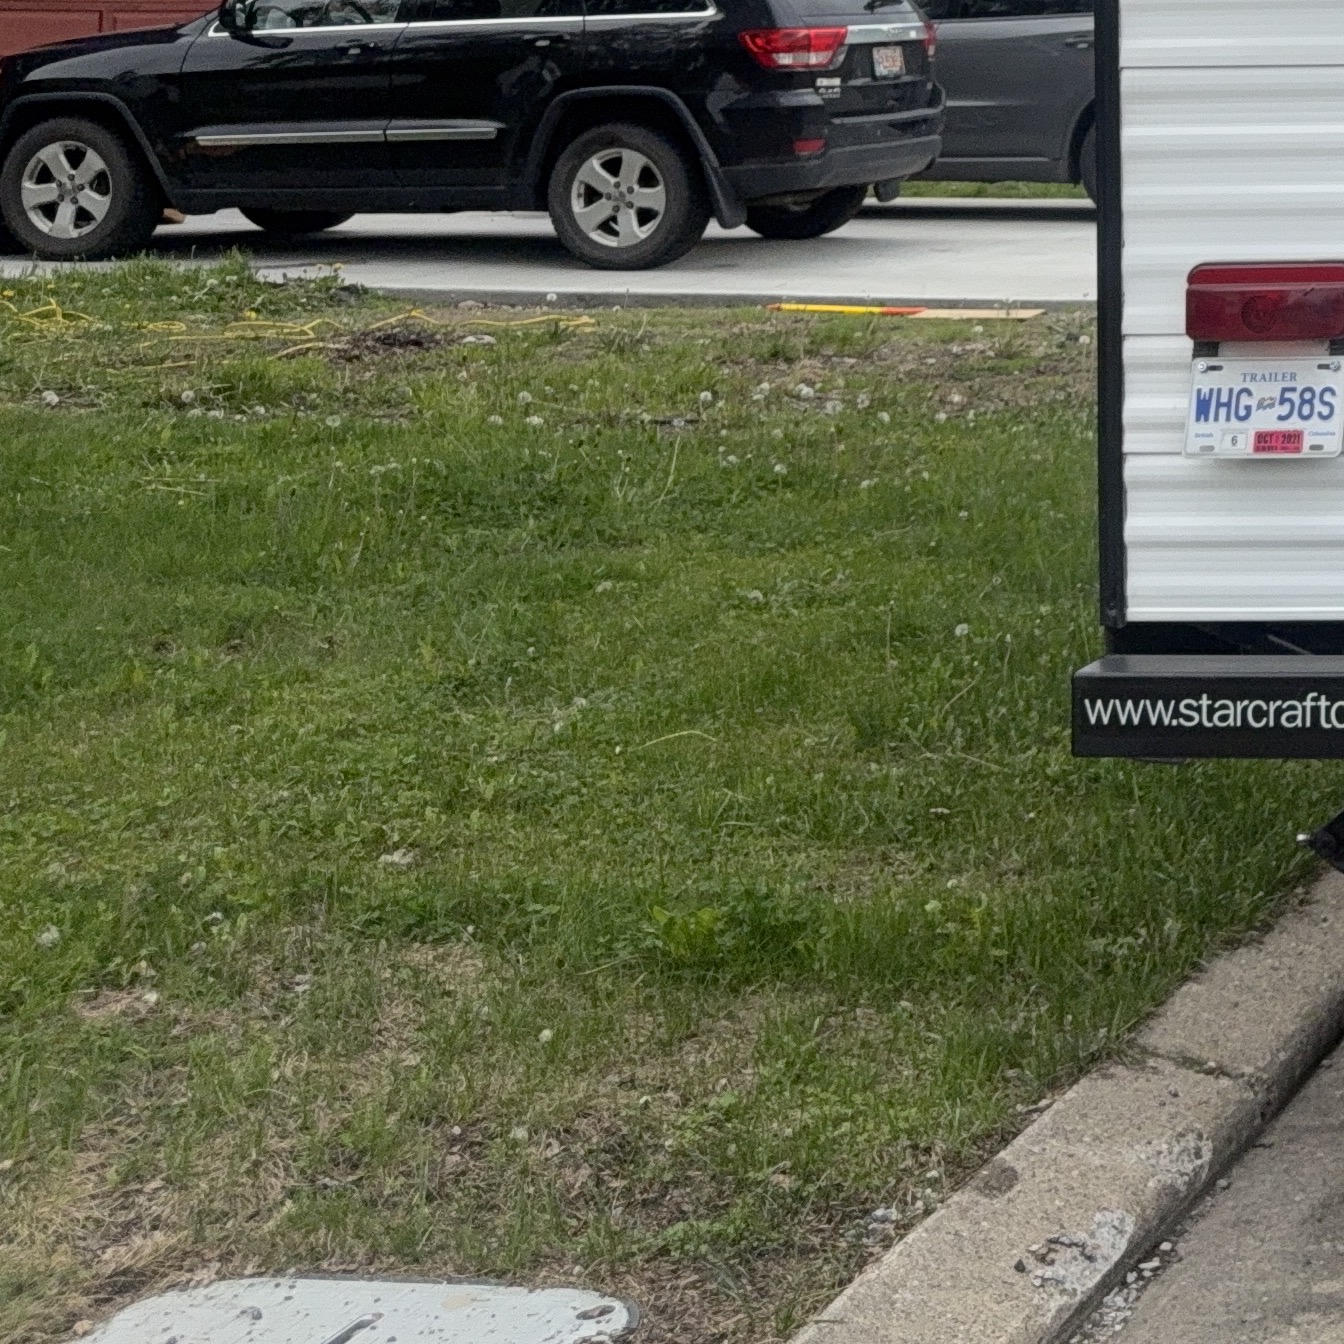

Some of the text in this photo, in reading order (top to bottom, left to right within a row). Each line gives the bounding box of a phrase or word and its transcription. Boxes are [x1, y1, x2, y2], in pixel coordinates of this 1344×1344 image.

[1241, 372, 1297, 383] TRAILER
[1195, 386, 1337, 422] WHG 58S
[1231, 436, 1238, 446] 6
[1257, 434, 1274, 444] OCT
